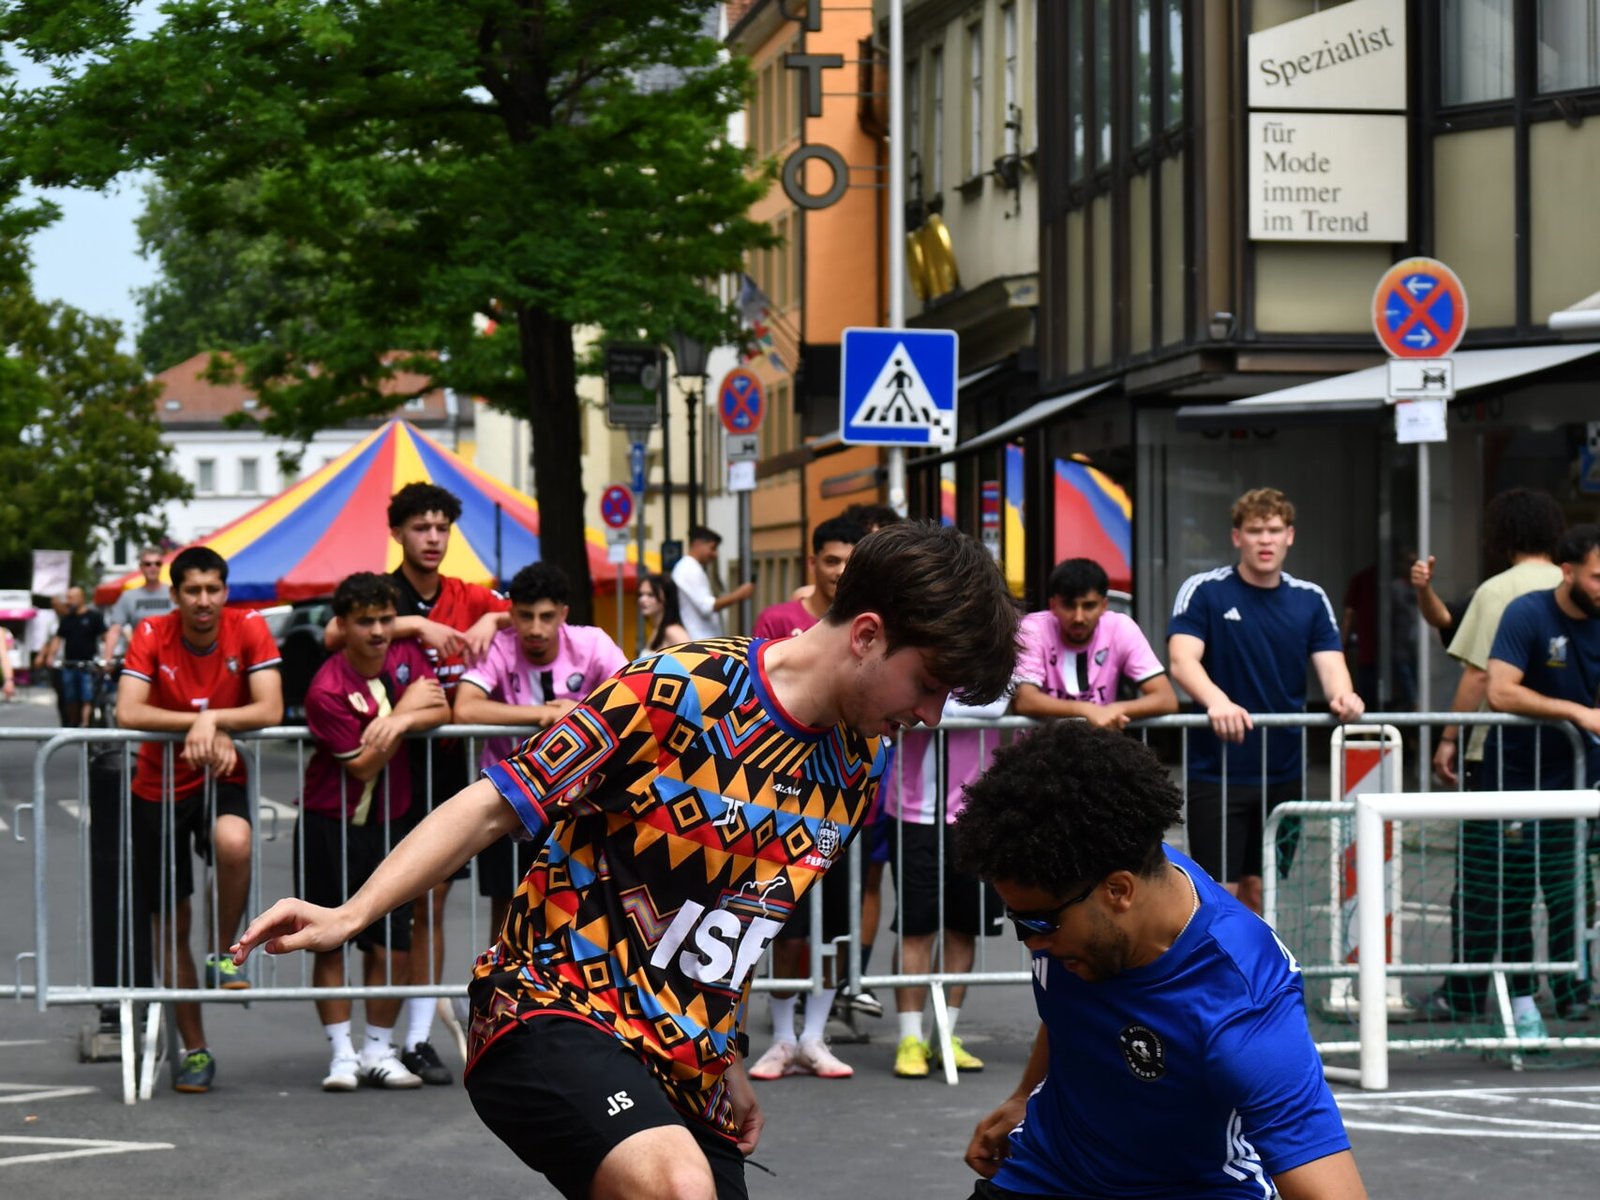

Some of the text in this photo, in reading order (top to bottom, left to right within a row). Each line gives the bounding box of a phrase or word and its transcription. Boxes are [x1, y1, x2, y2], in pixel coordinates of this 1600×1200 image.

[1260, 25, 1394, 87] Spezialist
[1263, 122, 1296, 143] für
[1264, 152, 1331, 173] Mode
[1264, 181, 1342, 203] immer
[1263, 210, 1369, 232] im Trend
[607, 1090, 634, 1116] JS
